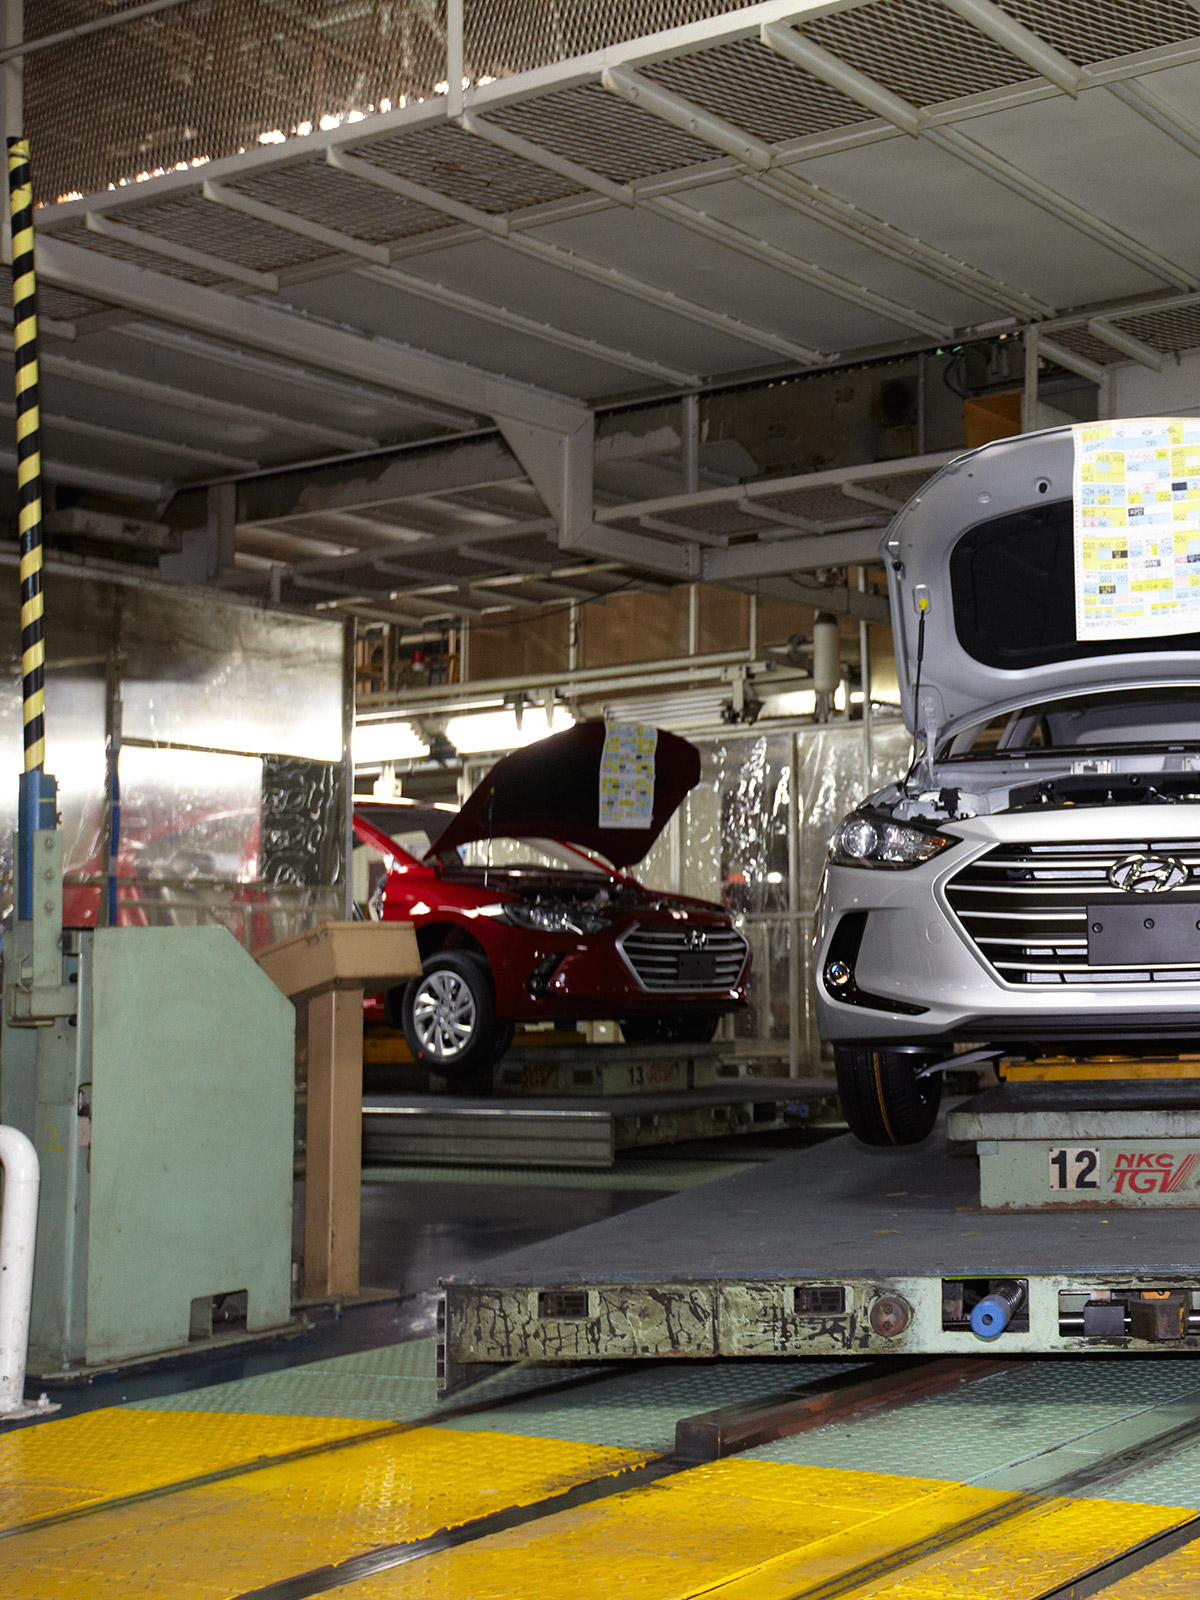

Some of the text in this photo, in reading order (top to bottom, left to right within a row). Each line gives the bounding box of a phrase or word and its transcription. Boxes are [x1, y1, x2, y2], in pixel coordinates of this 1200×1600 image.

[628, 1066, 644, 1085] 13
[42, 1124, 65, 1152] 2
[1051, 1150, 1097, 1189] 12
[1115, 1153, 1175, 1168] NKC
